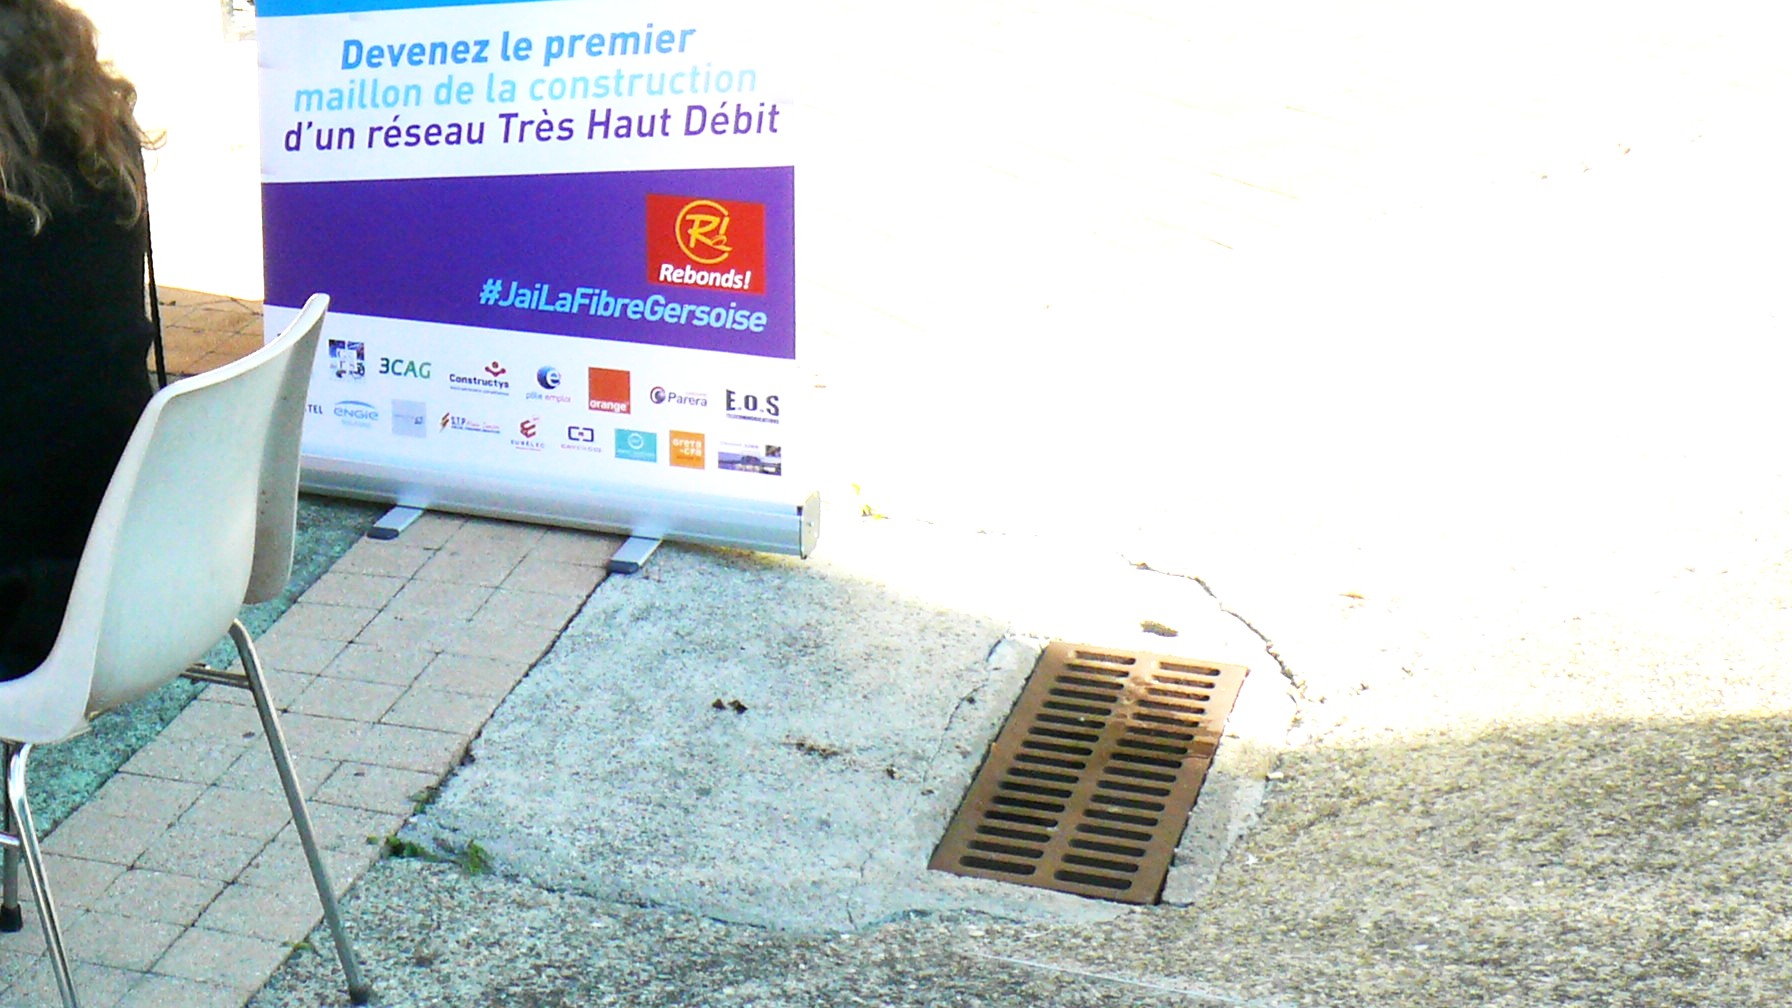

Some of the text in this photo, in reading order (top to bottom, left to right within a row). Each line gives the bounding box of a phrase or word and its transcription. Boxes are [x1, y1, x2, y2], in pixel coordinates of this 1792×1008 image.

[340, 23, 696, 71] Devenez le premier
[293, 62, 758, 113] maillon de la construction
[366, 114, 486, 150] réseau
[498, 109, 576, 144] Très
[586, 106, 671, 141] Haut
[683, 101, 781, 138] Débit
[659, 263, 752, 290] Rebonds!
[478, 277, 768, 334] #JaiLaFibreGersoise
[449, 373, 510, 390] Constructys
[306, 403, 324, 416] TEL
[589, 399, 628, 413] orange
[668, 391, 708, 407] Parera
